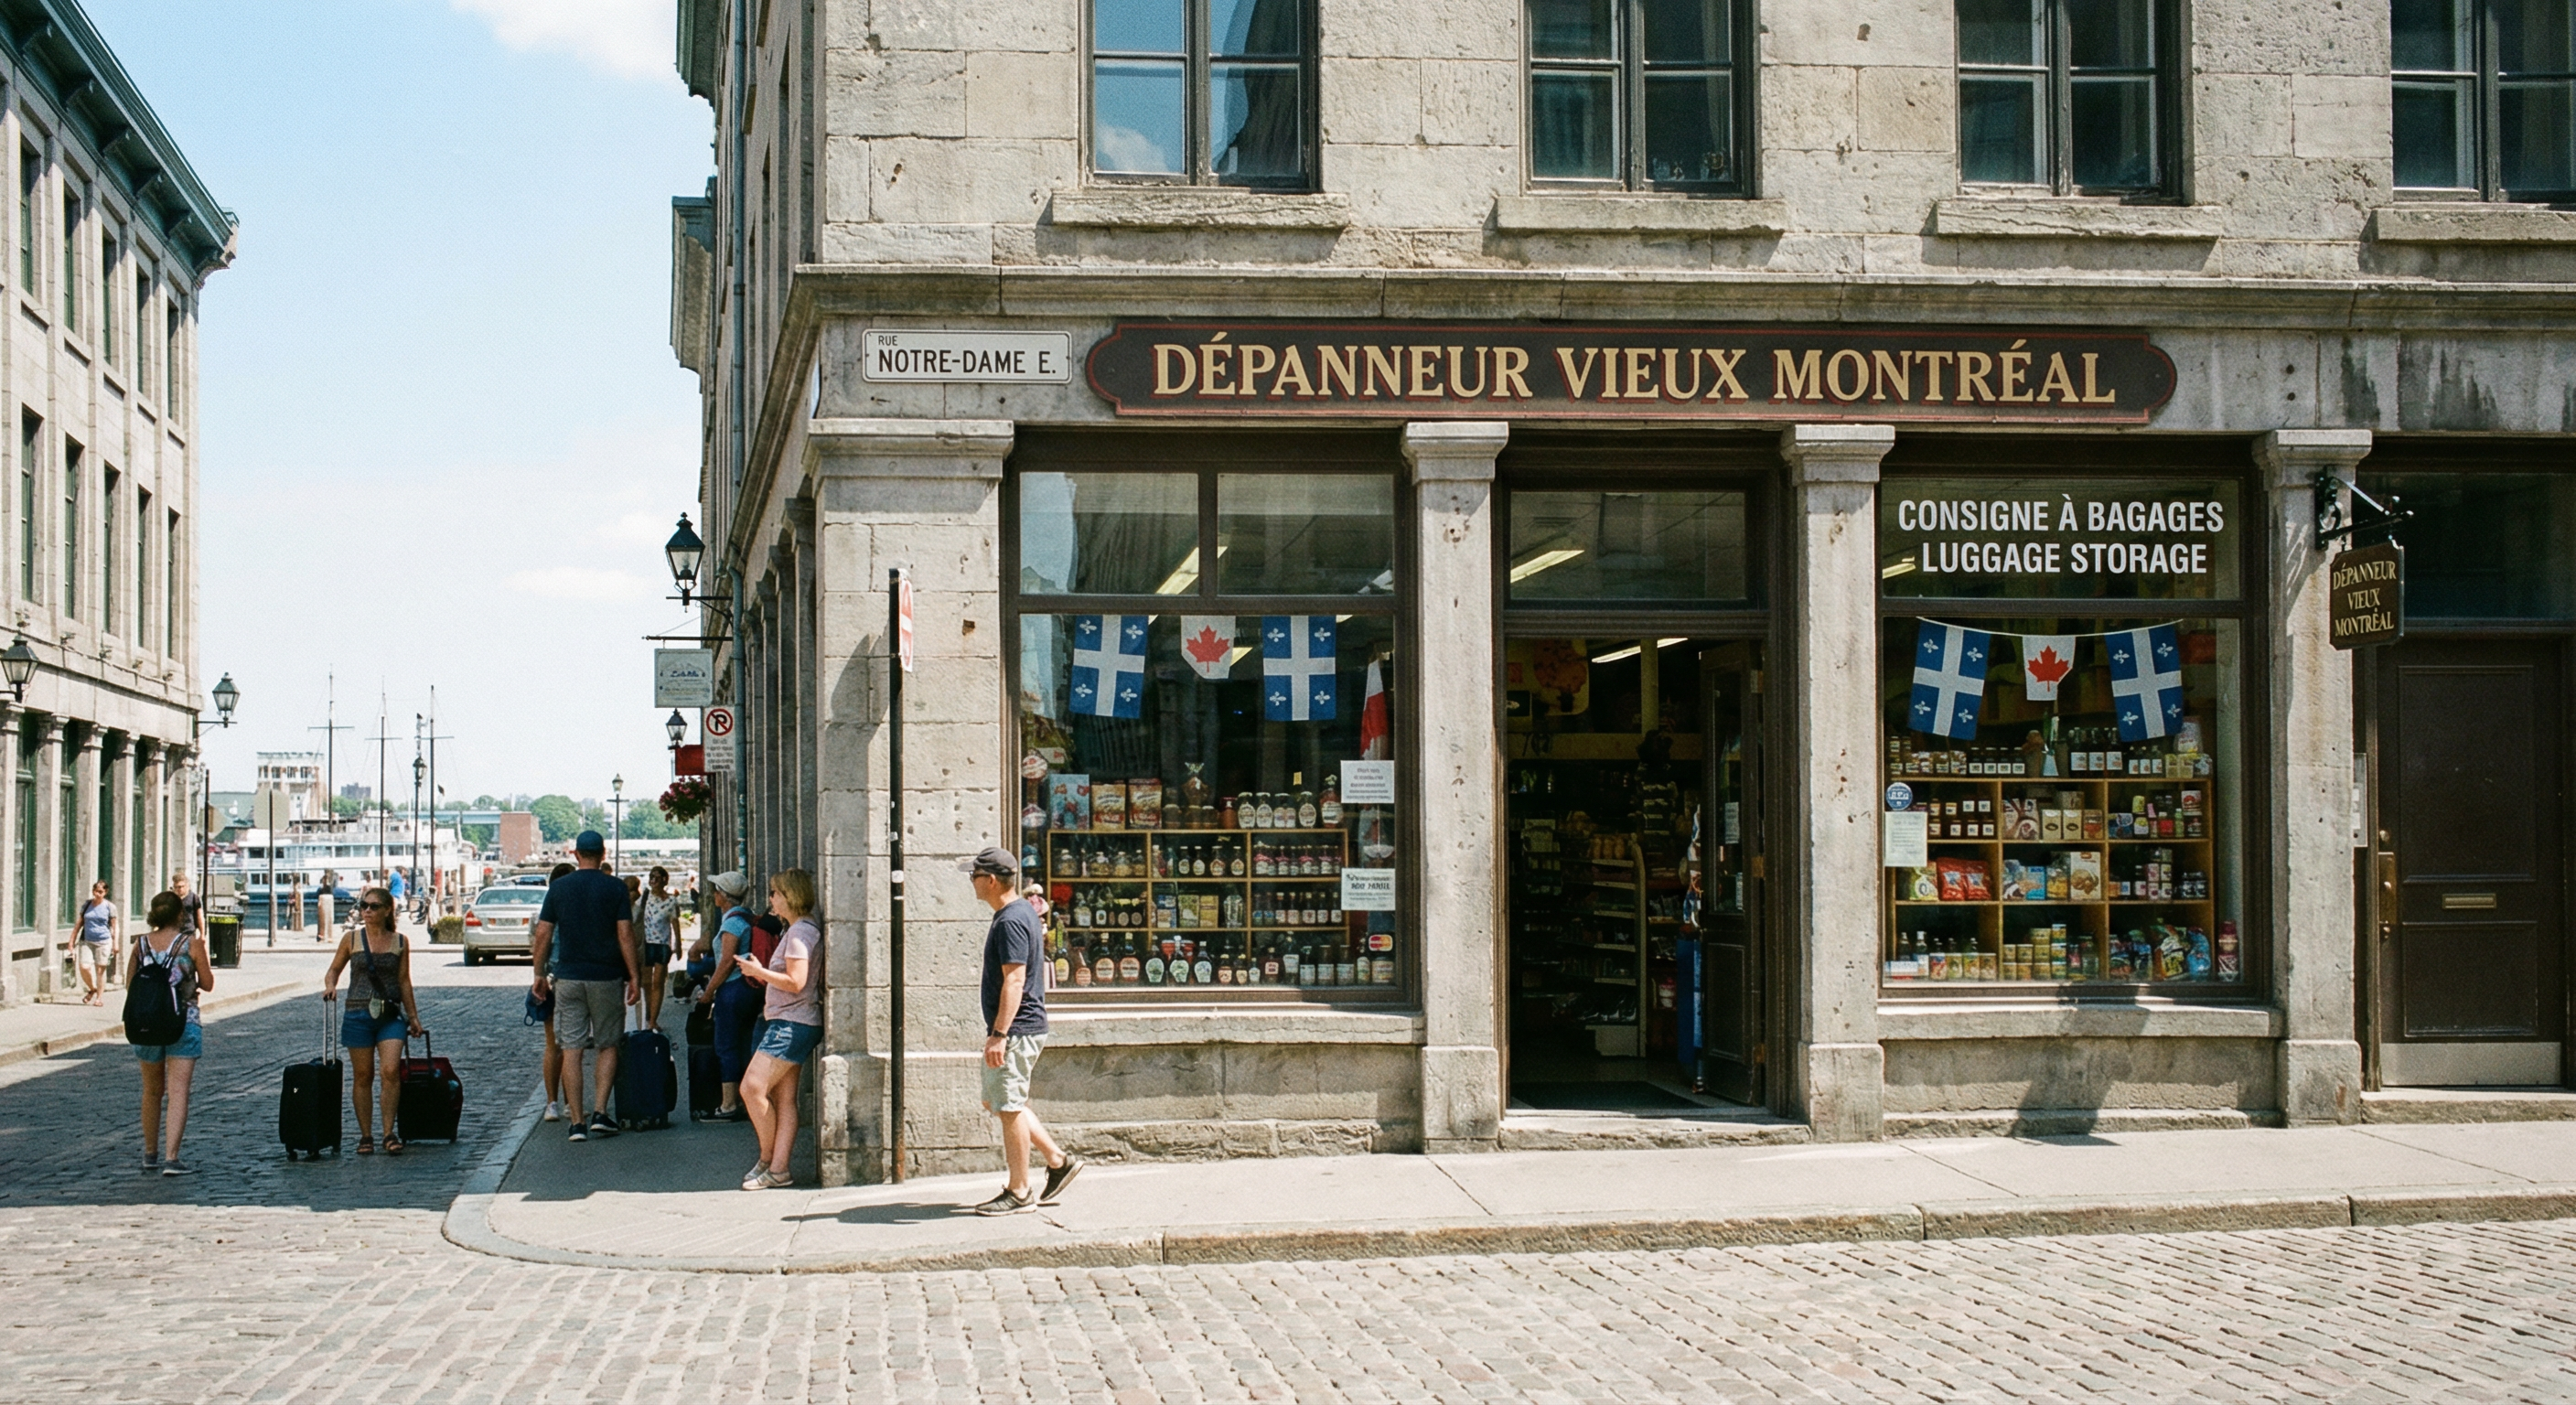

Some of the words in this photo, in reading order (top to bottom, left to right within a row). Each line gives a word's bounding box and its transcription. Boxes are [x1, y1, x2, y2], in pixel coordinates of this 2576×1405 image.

[878, 335, 898, 347] RUE
[878, 349, 1026, 374] NOTRE-DAME
[1038, 350, 1057, 374] E.
[1154, 331, 1533, 397] DÉPANNEUR
[1556, 348, 1749, 399] VIEUX
[1774, 339, 2115, 402] MONTRÉAL
[1898, 499, 2049, 531] CONSIGNE
[2058, 494, 2078, 531] À
[2088, 500, 2224, 532] BAGAGES
[1923, 542, 2060, 574] LUGGAGE
[2071, 542, 2207, 574] STORAGE
[2333, 560, 2397, 591] DÉPANNEUR
[2347, 587, 2381, 611] VIEUX
[2334, 607, 2395, 637] MONTRÉAL
